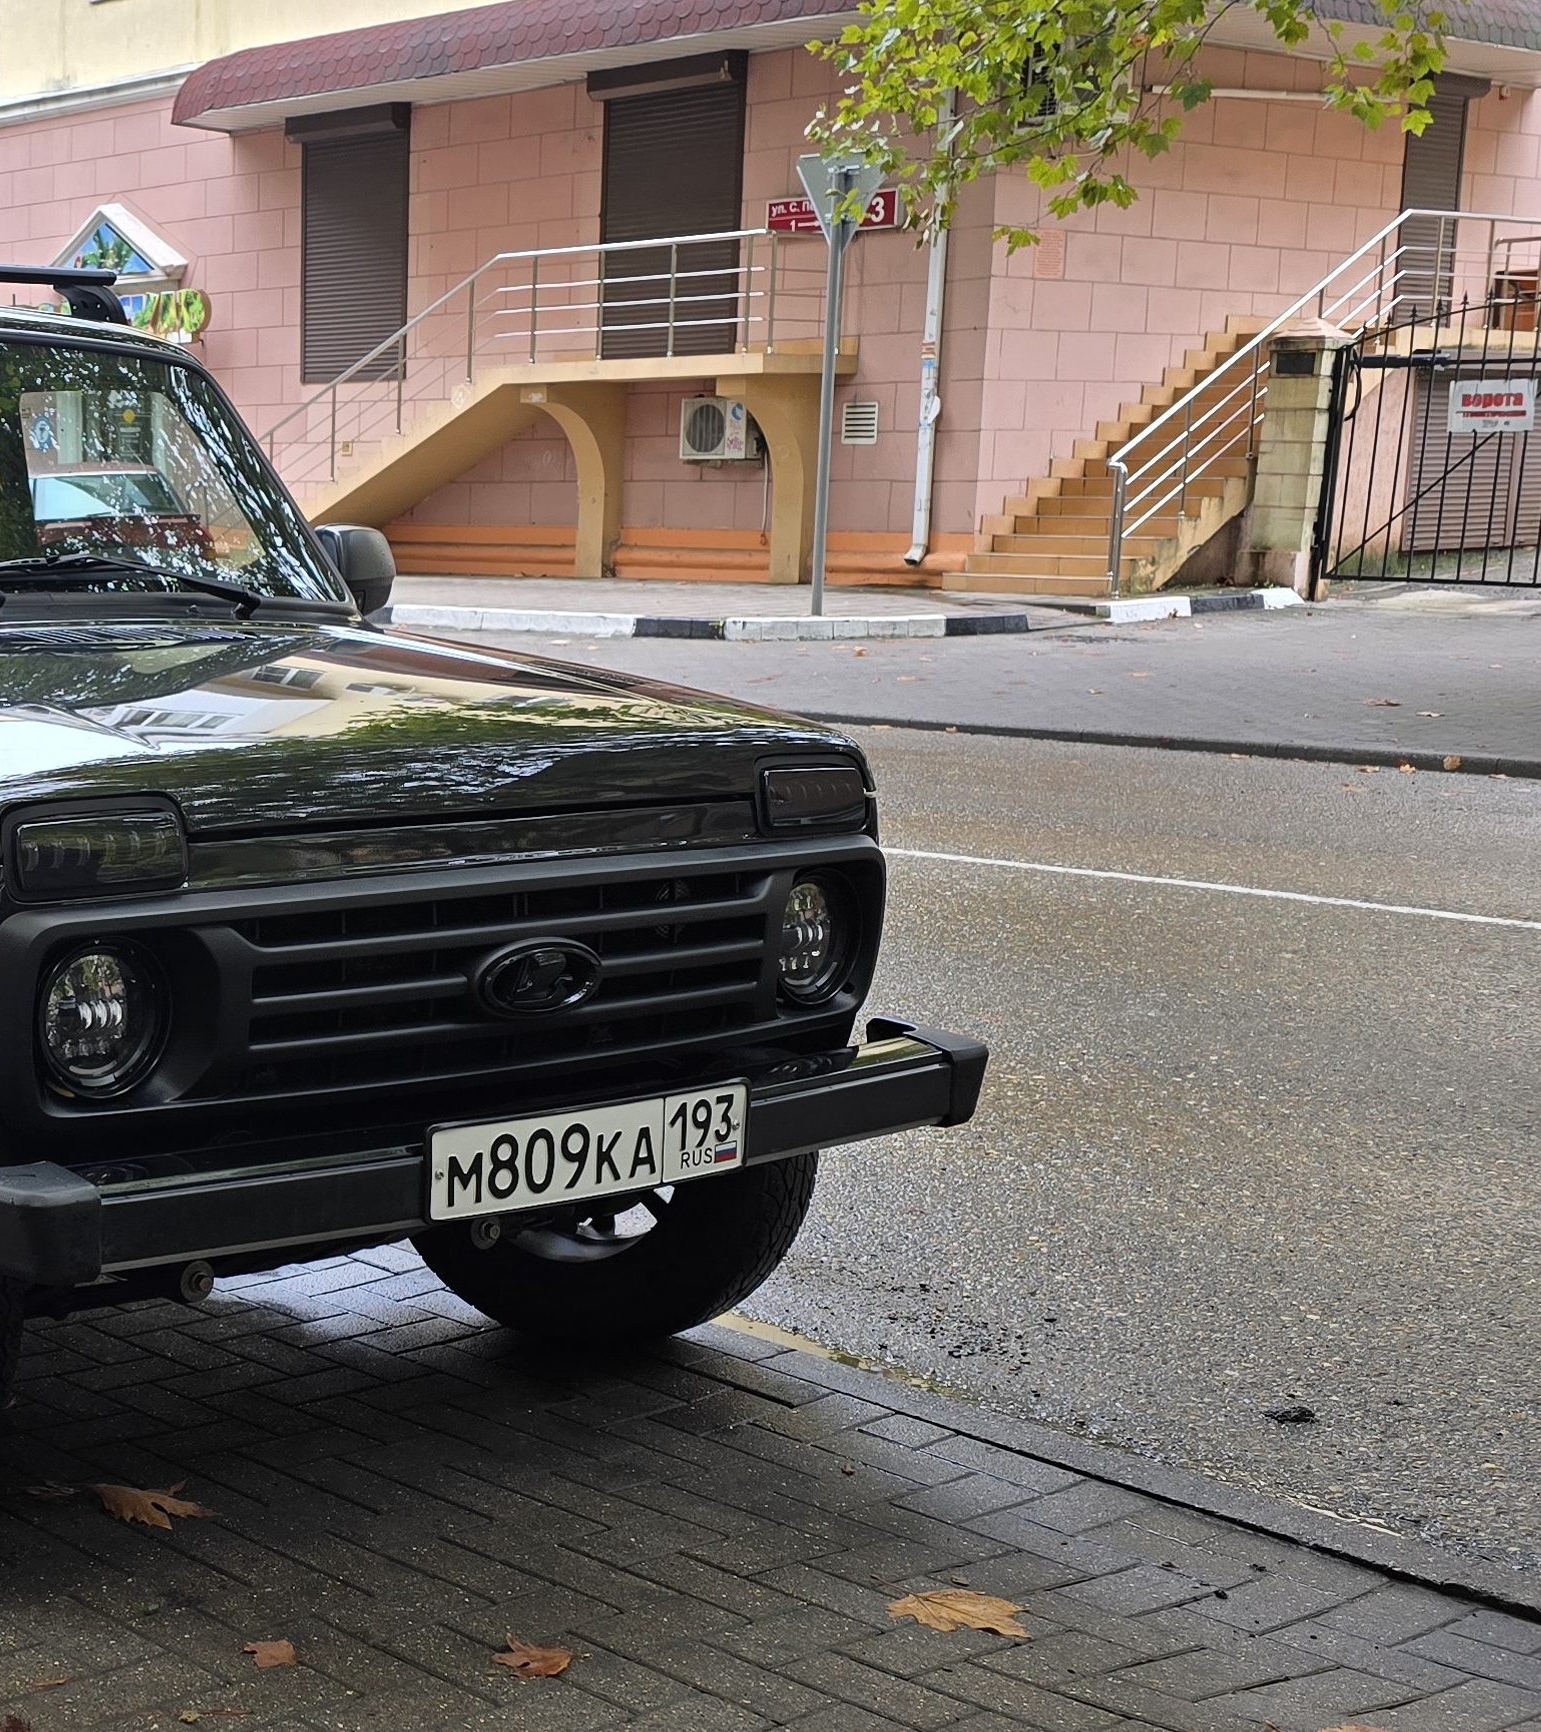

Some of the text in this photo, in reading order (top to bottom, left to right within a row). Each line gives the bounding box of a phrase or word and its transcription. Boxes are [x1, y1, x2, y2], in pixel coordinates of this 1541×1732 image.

[771, 204, 788, 217] ул.
[789, 201, 800, 213] С.
[871, 196, 885, 223] 3
[790, 219, 796, 232] 1
[1461, 392, 1523, 408] ворота
[447, 1093, 735, 1208] М809КА 193
[680, 1148, 713, 1170] RUS
